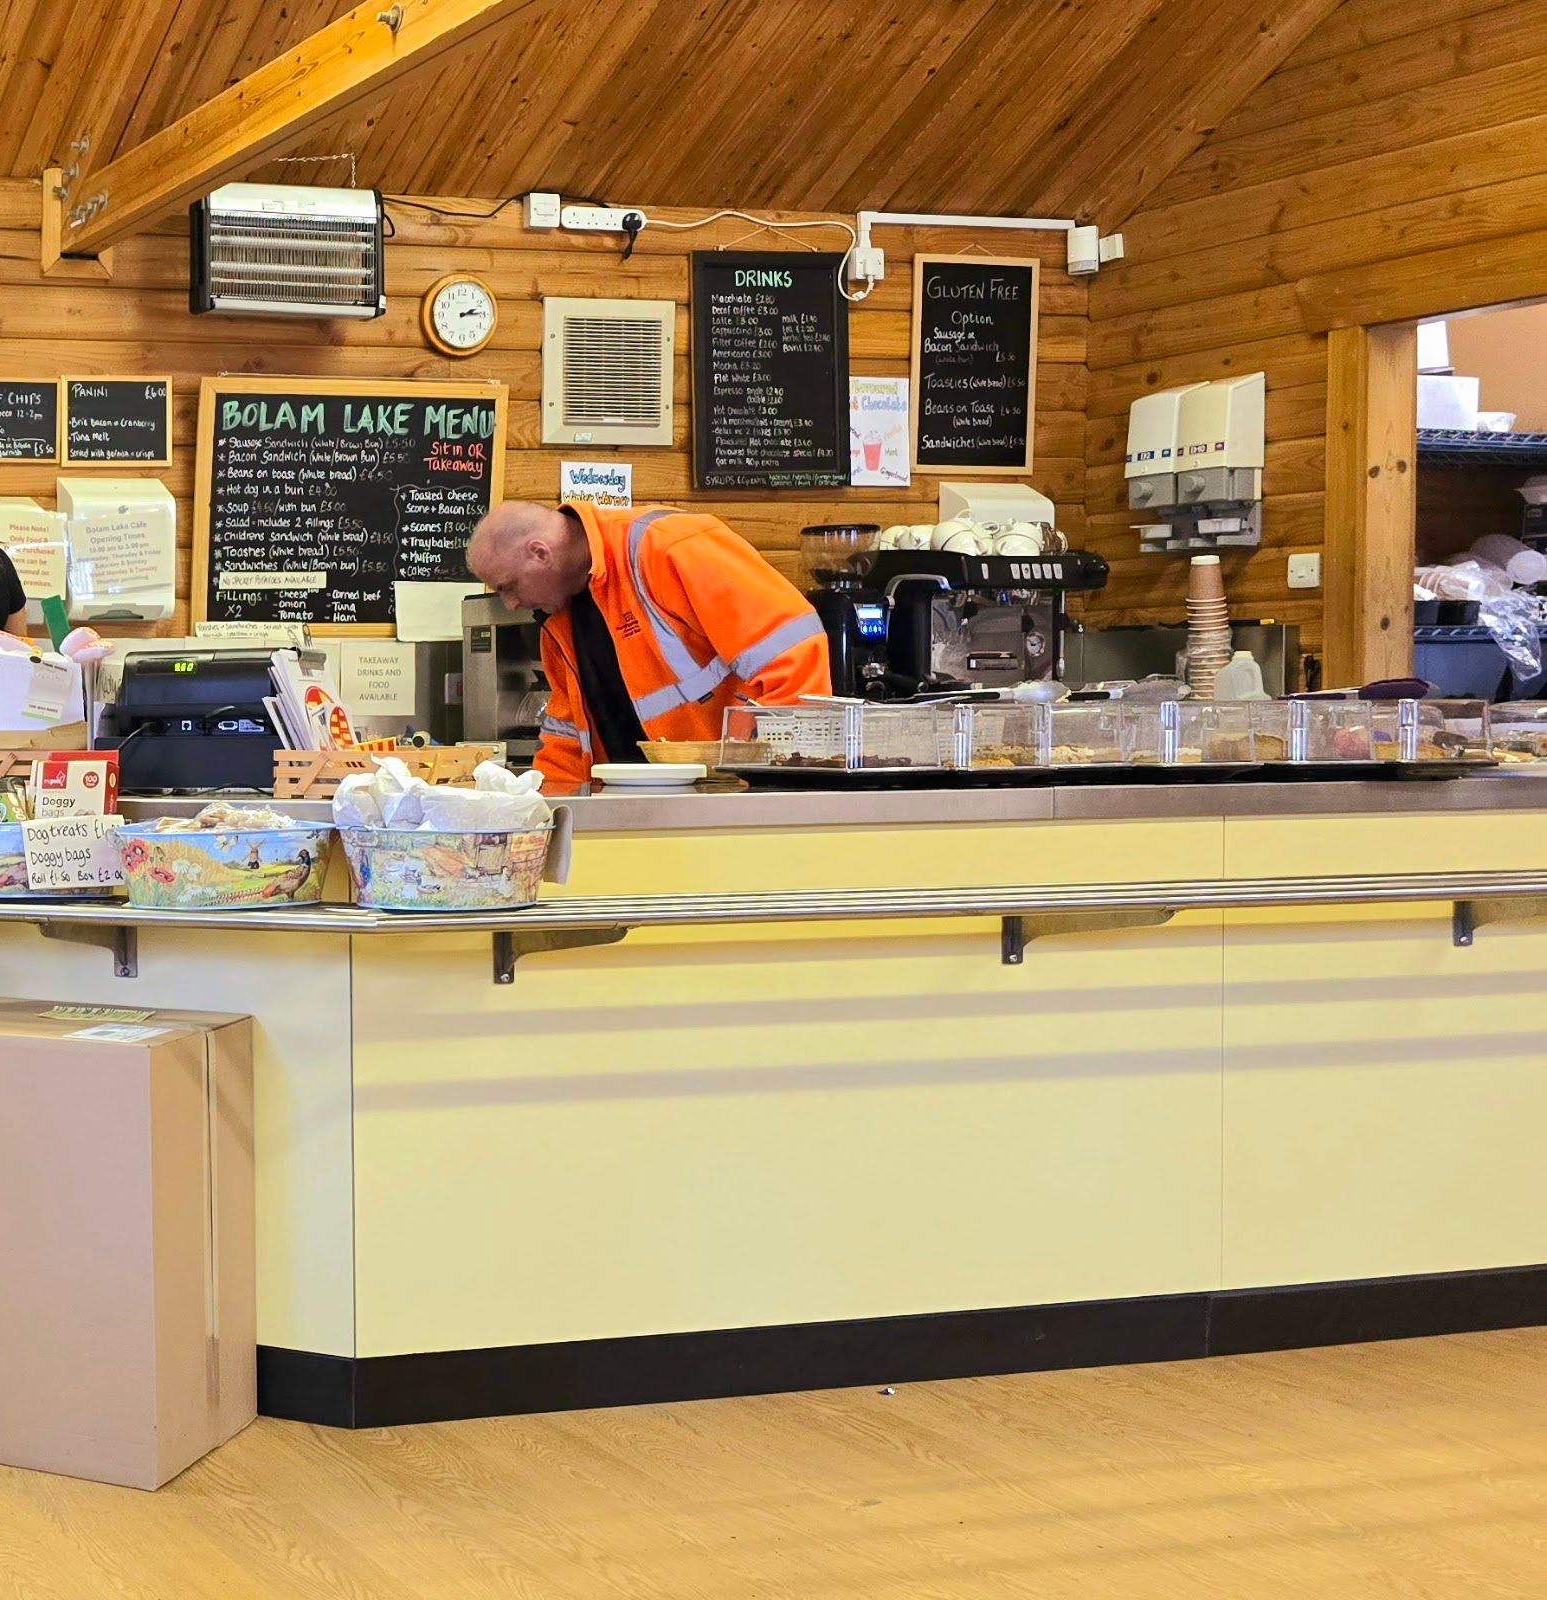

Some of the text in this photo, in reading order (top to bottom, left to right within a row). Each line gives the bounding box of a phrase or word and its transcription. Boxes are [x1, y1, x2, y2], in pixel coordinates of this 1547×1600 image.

[735, 270, 793, 288] DRINKS
[458, 288, 467, 296] 12
[990, 278, 1019, 300] FREE
[951, 310, 993, 330] Option
[924, 338, 952, 353] Bacon
[72, 384, 108, 399] PANINI
[8, 392, 42, 405] CHIPS
[925, 398, 954, 416] Beans
[222, 400, 496, 440] BOLAM LAKE MENU
[264, 437, 308, 448] Sandwich
[922, 435, 975, 449] Sandwiches
[228, 451, 257, 464] Bacon
[261, 449, 306, 464] Sandwich
[468, 443, 487, 459] OR
[227, 467, 253, 479] Beans
[257, 470, 268, 478] on
[423, 457, 483, 480] Takeaway
[569, 468, 626, 493] Wednesday
[227, 484, 241, 495] Hot
[244, 484, 259, 497] dog
[274, 486, 280, 494] a
[284, 483, 304, 495] bun
[409, 490, 443, 501] Toasted
[225, 502, 249, 514] Soup
[301, 502, 316, 512] bun
[438, 504, 465, 515] Bacon
[131, 521, 147, 529] Cafe
[225, 516, 250, 527] Salad
[295, 517, 301, 527] 2
[90, 535, 122, 544] Opening
[224, 530, 264, 541] Childrens
[410, 552, 441, 564] Muffins
[223, 560, 278, 571] Sandwiches
[333, 602, 356, 612] Tuna
[278, 610, 314, 620] Tomato
[333, 613, 357, 622] Ham
[369, 681, 389, 689] FOOD
[359, 693, 397, 701] AVAILABLE
[42, 796, 75, 808] Doggy
[41, 808, 64, 817] bags
[27, 828, 49, 845] Dog
[31, 848, 91, 868] Doggy bags
[77, 872, 94, 881] Box
